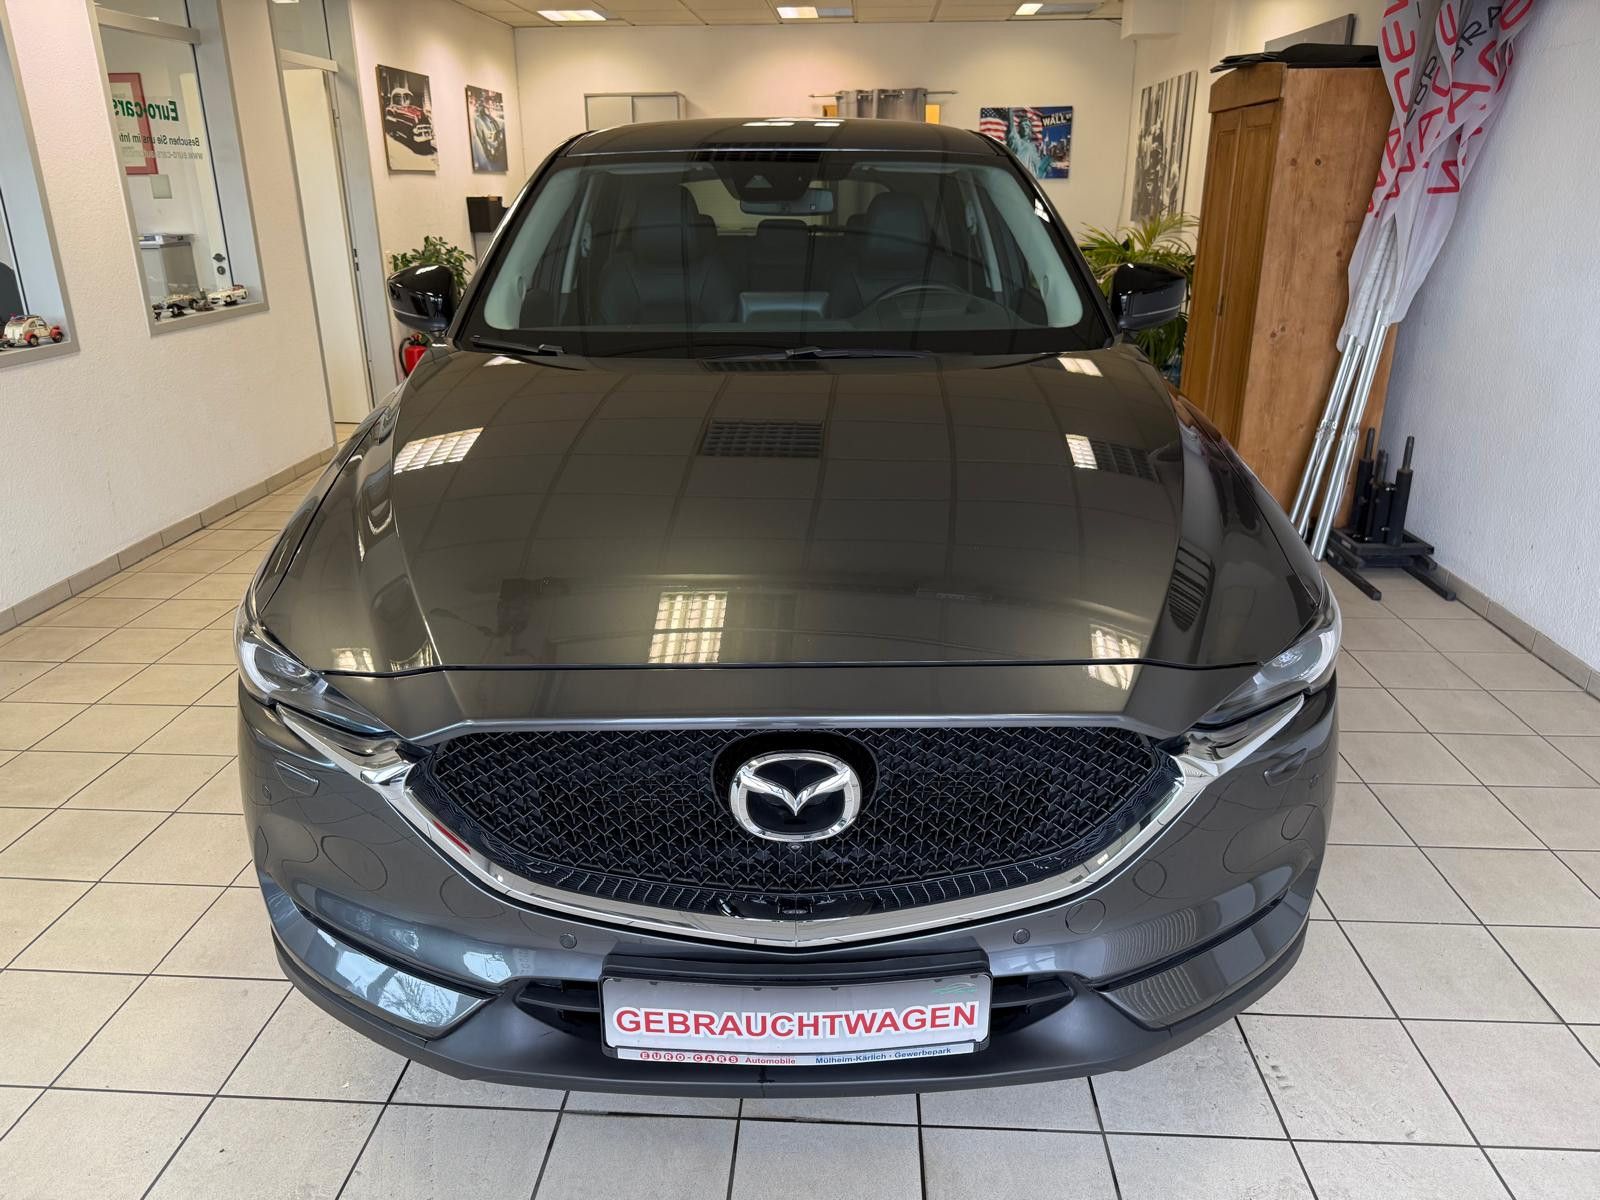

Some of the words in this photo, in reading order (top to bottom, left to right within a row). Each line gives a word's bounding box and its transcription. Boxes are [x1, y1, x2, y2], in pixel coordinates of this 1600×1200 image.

[1042, 114, 1066, 127] WALL
[615, 1003, 976, 1038] GEBRAUCHTWAGEN
[639, 1051, 739, 1064] EURO-CARS
[745, 1056, 796, 1065] Automobile
[815, 1053, 887, 1064] Mülheim-Kärlich
[894, 1047, 952, 1059] Gewerbepark
